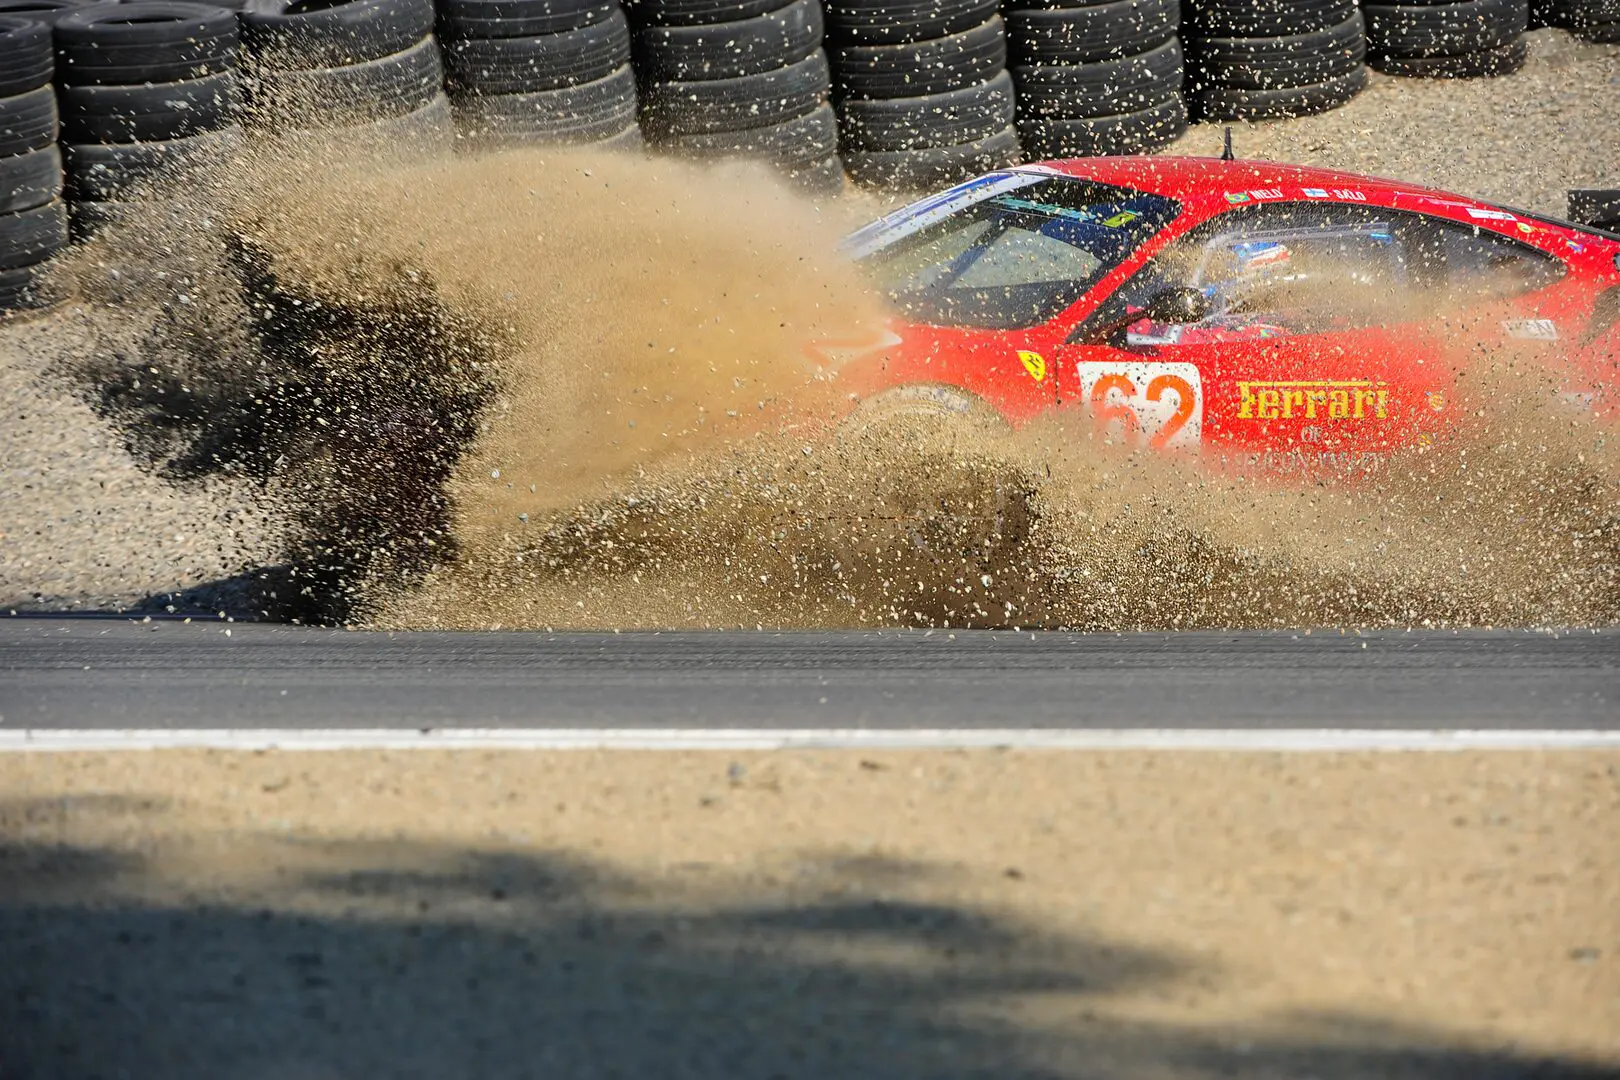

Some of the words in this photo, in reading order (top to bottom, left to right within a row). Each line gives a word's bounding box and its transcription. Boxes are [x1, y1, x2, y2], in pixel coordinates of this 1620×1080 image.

[1249, 188, 1284, 200] MELO
[1333, 189, 1367, 201] SALO
[1090, 373, 1195, 450] 62
[1236, 381, 1388, 419] Ferrari
